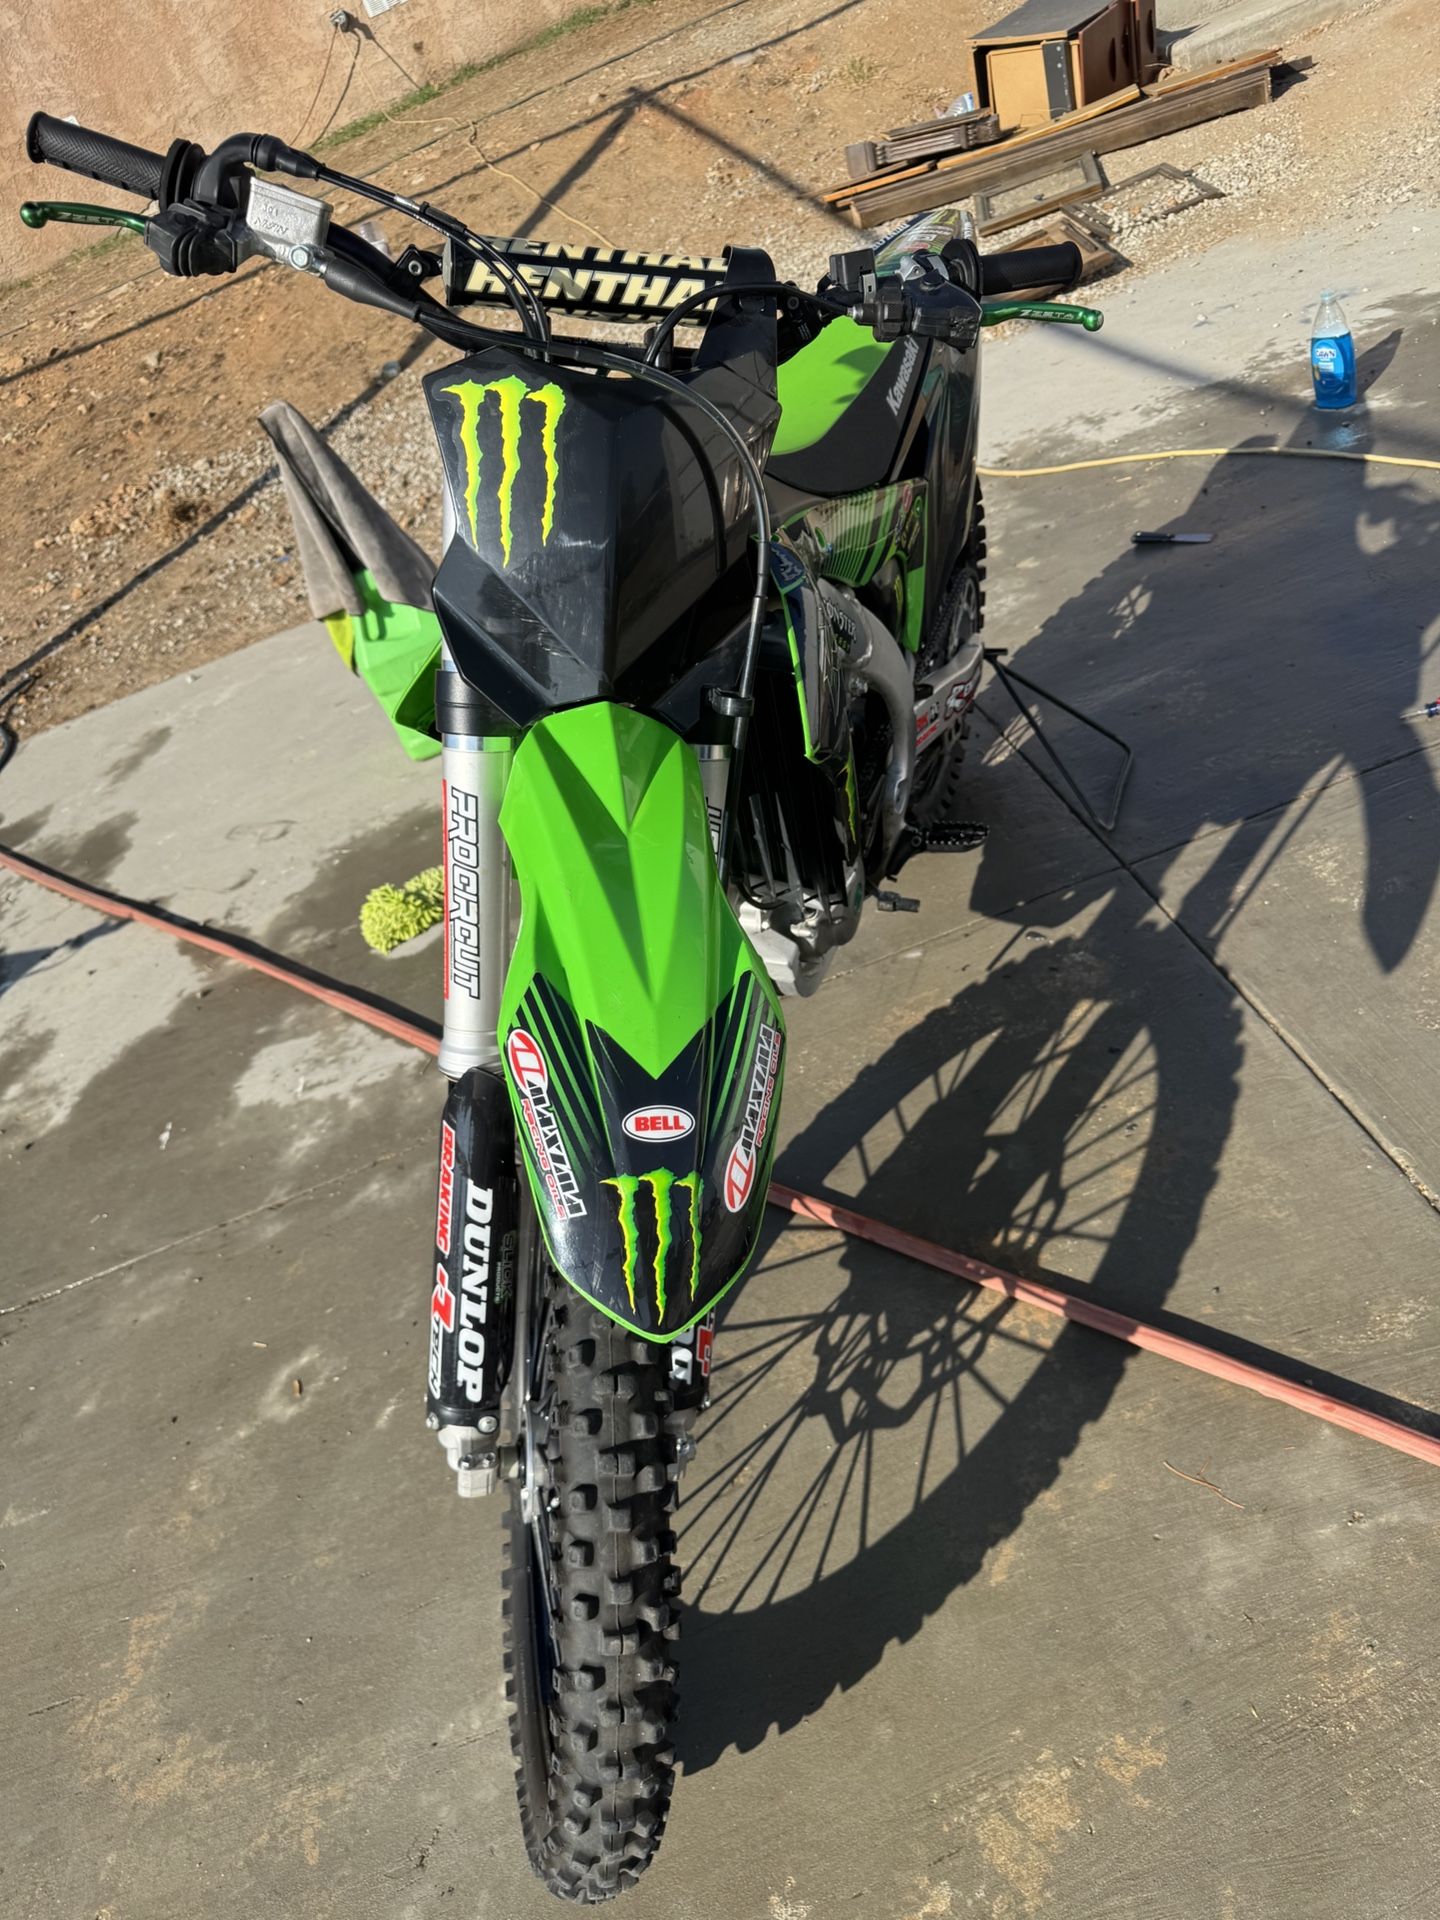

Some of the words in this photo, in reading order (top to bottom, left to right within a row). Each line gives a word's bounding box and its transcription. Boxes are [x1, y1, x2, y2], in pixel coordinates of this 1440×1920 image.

[886, 334, 919, 416] Kawasaki
[526, 1080, 587, 1218] MAXIMA
[634, 1115, 686, 1131] BELL
[739, 1023, 775, 1158] MAXIMA
[756, 1076, 775, 1148] RACING
[770, 1031, 782, 1076] OILS
[437, 1120, 455, 1256] BRAKING
[521, 1098, 549, 1170] RACING
[546, 1171, 567, 1221] OILS
[457, 1178, 493, 1404] DUNLOP
